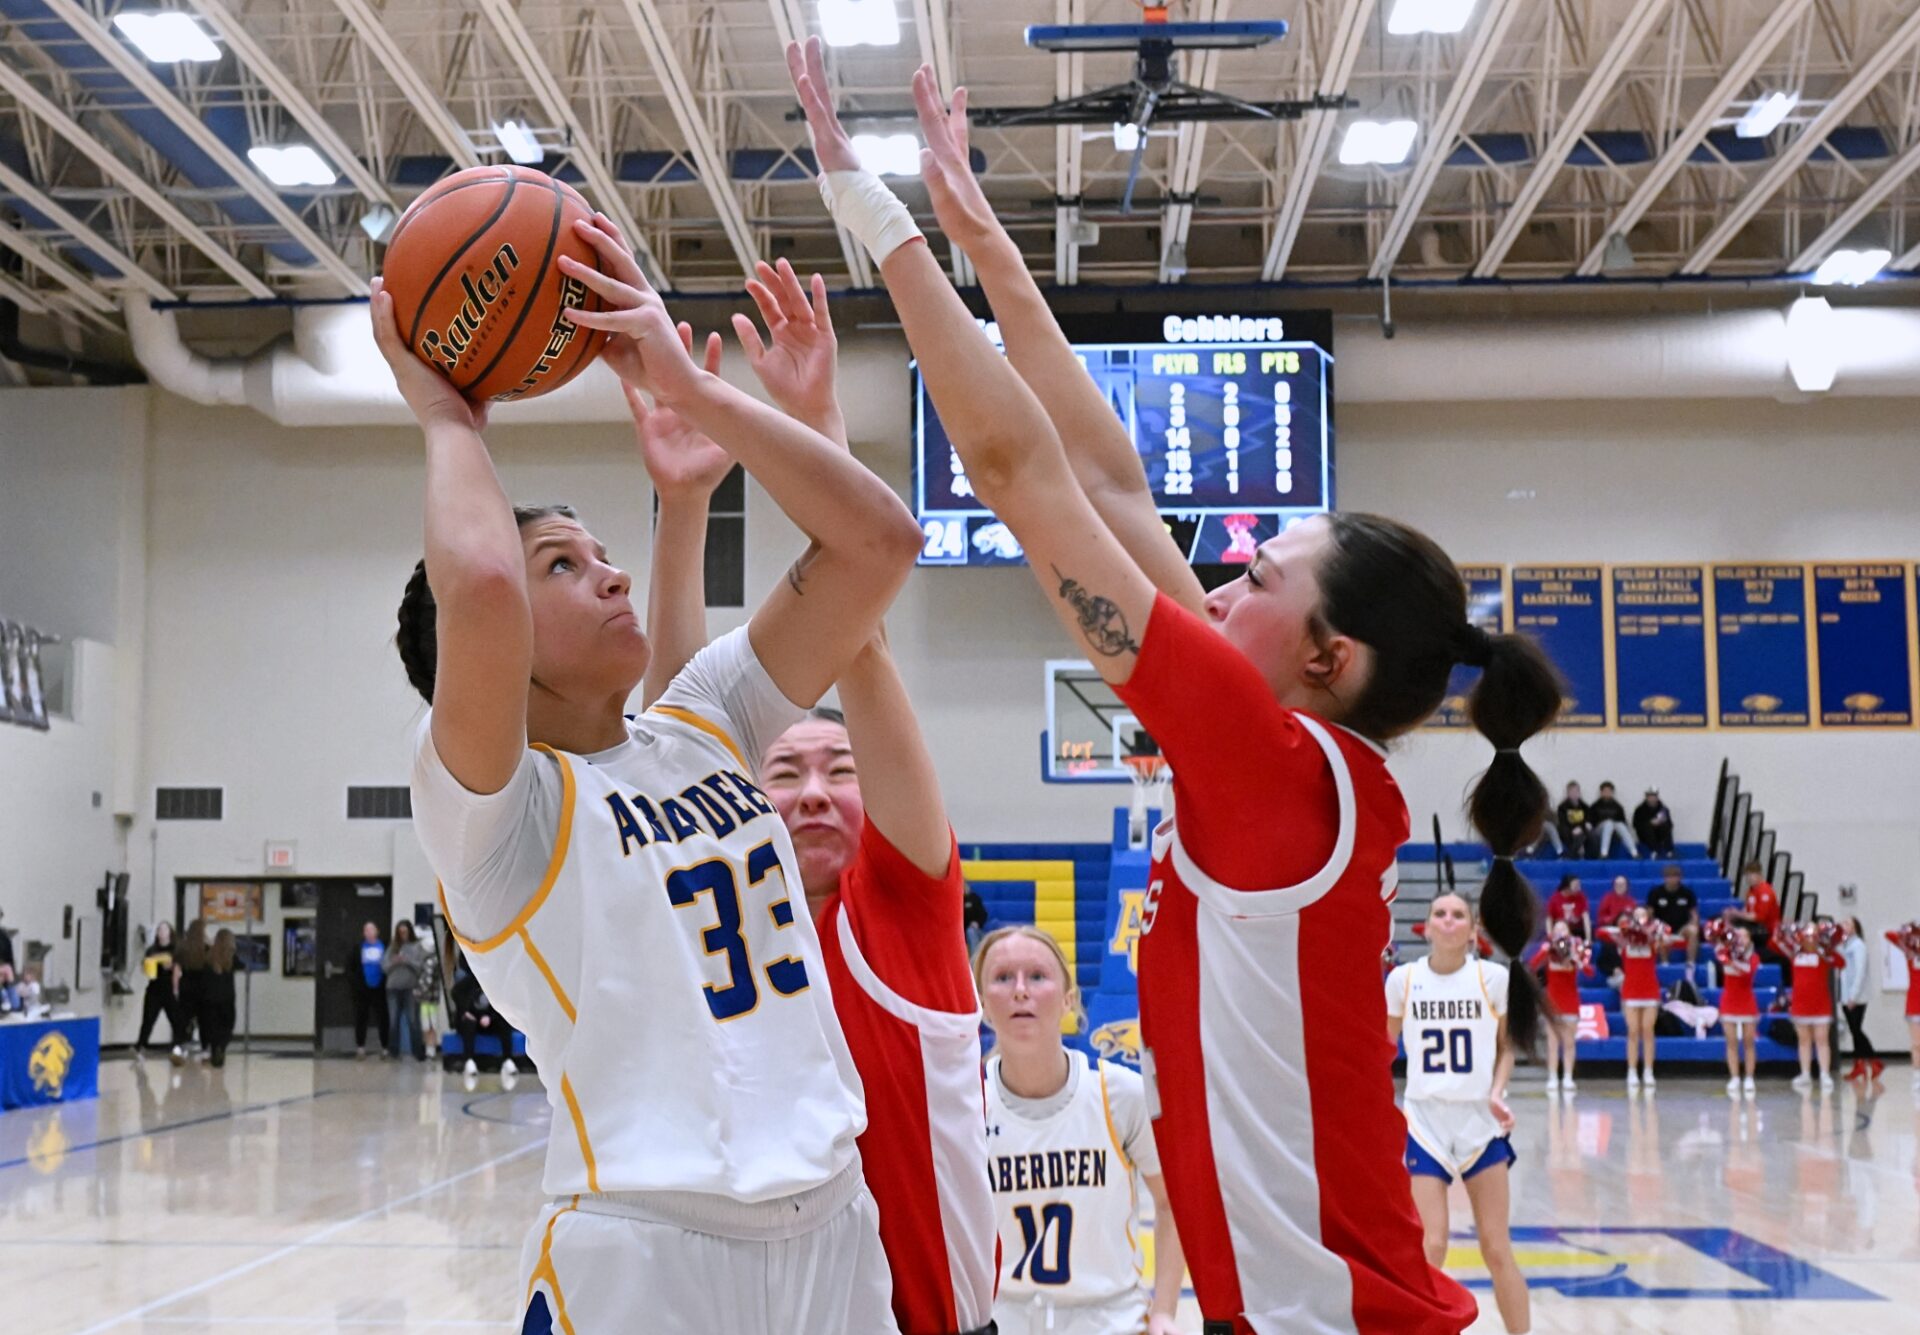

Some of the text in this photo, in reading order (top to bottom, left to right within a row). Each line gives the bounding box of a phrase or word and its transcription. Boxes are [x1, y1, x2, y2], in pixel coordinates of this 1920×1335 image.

[420, 242, 520, 370] Baden
[1163, 314, 1284, 342] Cobblers
[1153, 351, 1300, 375] PLYR FLS PTS
[1169, 382, 1185, 405] 2
[1223, 381, 1239, 404] 2
[1165, 427, 1191, 449] 14
[1275, 426, 1291, 449] 2
[1226, 449, 1238, 471] 1
[1164, 472, 1193, 495] 22
[1226, 471, 1239, 494] 1
[923, 520, 963, 557] 24
[664, 837, 810, 1023] 33
[1421, 1027, 1474, 1074] 20
[1011, 1203, 1073, 1286] 10
